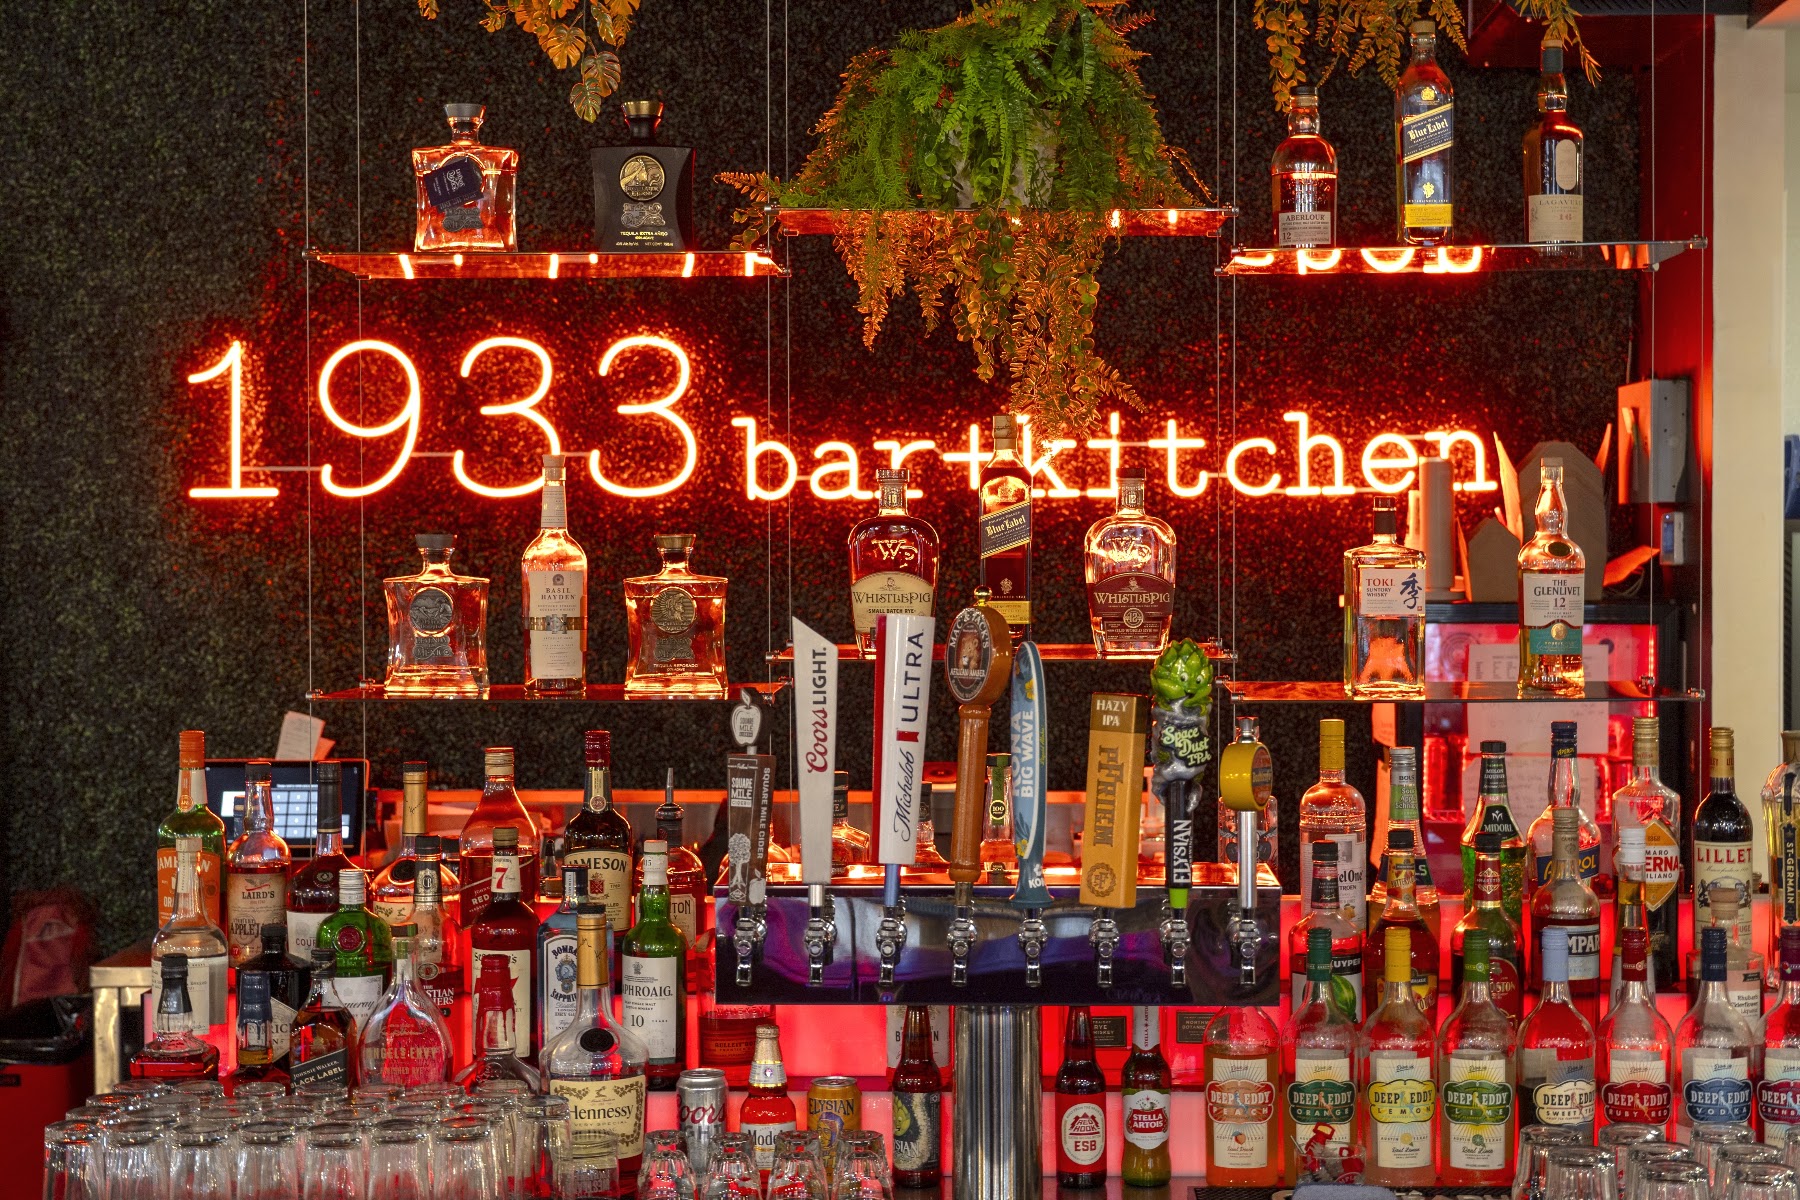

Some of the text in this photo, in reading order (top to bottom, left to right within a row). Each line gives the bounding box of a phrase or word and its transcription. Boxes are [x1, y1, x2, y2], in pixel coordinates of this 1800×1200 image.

[1407, 118, 1449, 141] Blue Label
[1286, 214, 1326, 222] ABERLOUR
[1282, 232, 1292, 240] 12
[186, 334, 699, 499] 1933
[1128, 494, 1137, 504] 12
[985, 514, 1026, 537] Blue Label
[1533, 586, 1581, 596] GLENLIVET
[1553, 597, 1566, 608] 12
[1129, 611, 1138, 623] 12
[949, 618, 964, 648] MAC
[901, 632, 925, 723] ULTRA
[1096, 699, 1130, 713] HAZY
[1102, 714, 1120, 727] IPA
[739, 724, 754, 732] MILE
[805, 707, 828, 774] Coors
[1161, 724, 1200, 749] Space
[1021, 710, 1034, 798] BIG WAVE
[1178, 736, 1209, 759] Dust
[1187, 751, 1212, 767] IPA
[731, 777, 753, 788] SQUARE
[731, 787, 752, 799] MILE
[894, 750, 916, 842] Michelob
[756, 767, 771, 859] SQUARE MILE CIDER
[1484, 823, 1511, 832] MIDORI
[1172, 819, 1191, 884] ELYSIAN
[1697, 847, 1752, 863] LILLET
[1645, 856, 1679, 872] ERNA
[494, 867, 508, 890] 7
[1786, 841, 1795, 904] ST-GERMAIN
[242, 891, 275, 899] LAIRD'S
[471, 893, 490, 906] RED
[631, 1014, 644, 1027] 10
[317, 1066, 344, 1080] LABEL
[1210, 1090, 1271, 1105] DEEP EDDY
[1293, 1091, 1353, 1105] DEEP EDDY
[1374, 1090, 1433, 1104] DEEP EDDY
[1447, 1090, 1508, 1105] DEEP EDDY
[1543, 1094, 1571, 1106] DEEP
[1608, 1092, 1668, 1106] DEEP EDDY
[1691, 1089, 1750, 1104] DEEP EDDY
[1762, 1089, 1787, 1105] DEEP
[570, 1104, 634, 1120] Hennessy
[808, 1097, 855, 1116] ELYSIAN
[1212, 1106, 1269, 1115] PEACH
[1377, 1106, 1431, 1115] LEMON
[1608, 1109, 1668, 1117] RUBY RED
[1696, 1107, 1747, 1116] VODKA
[1133, 1113, 1163, 1121] STELLA
[1133, 1120, 1164, 1129] ARTOIS
[1074, 1140, 1097, 1151] ESB
